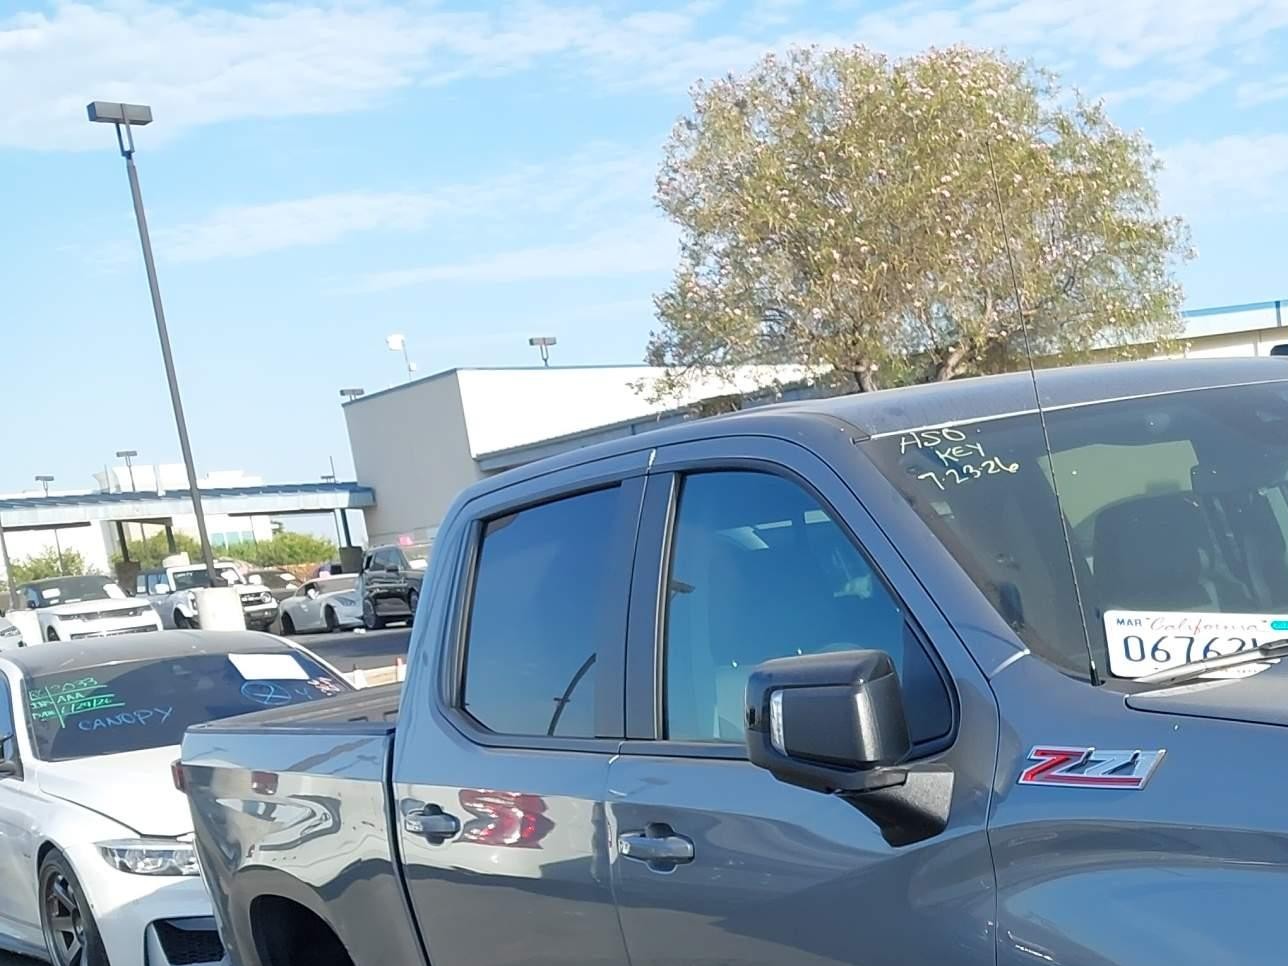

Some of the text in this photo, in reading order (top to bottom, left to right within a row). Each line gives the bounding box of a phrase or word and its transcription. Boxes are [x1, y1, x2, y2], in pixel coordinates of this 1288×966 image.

[935, 442, 985, 466] KEY
[1116, 618, 1142, 627] MAR
[78, 706, 173, 731] CANOPY
[1018, 745, 1166, 790] Z71
